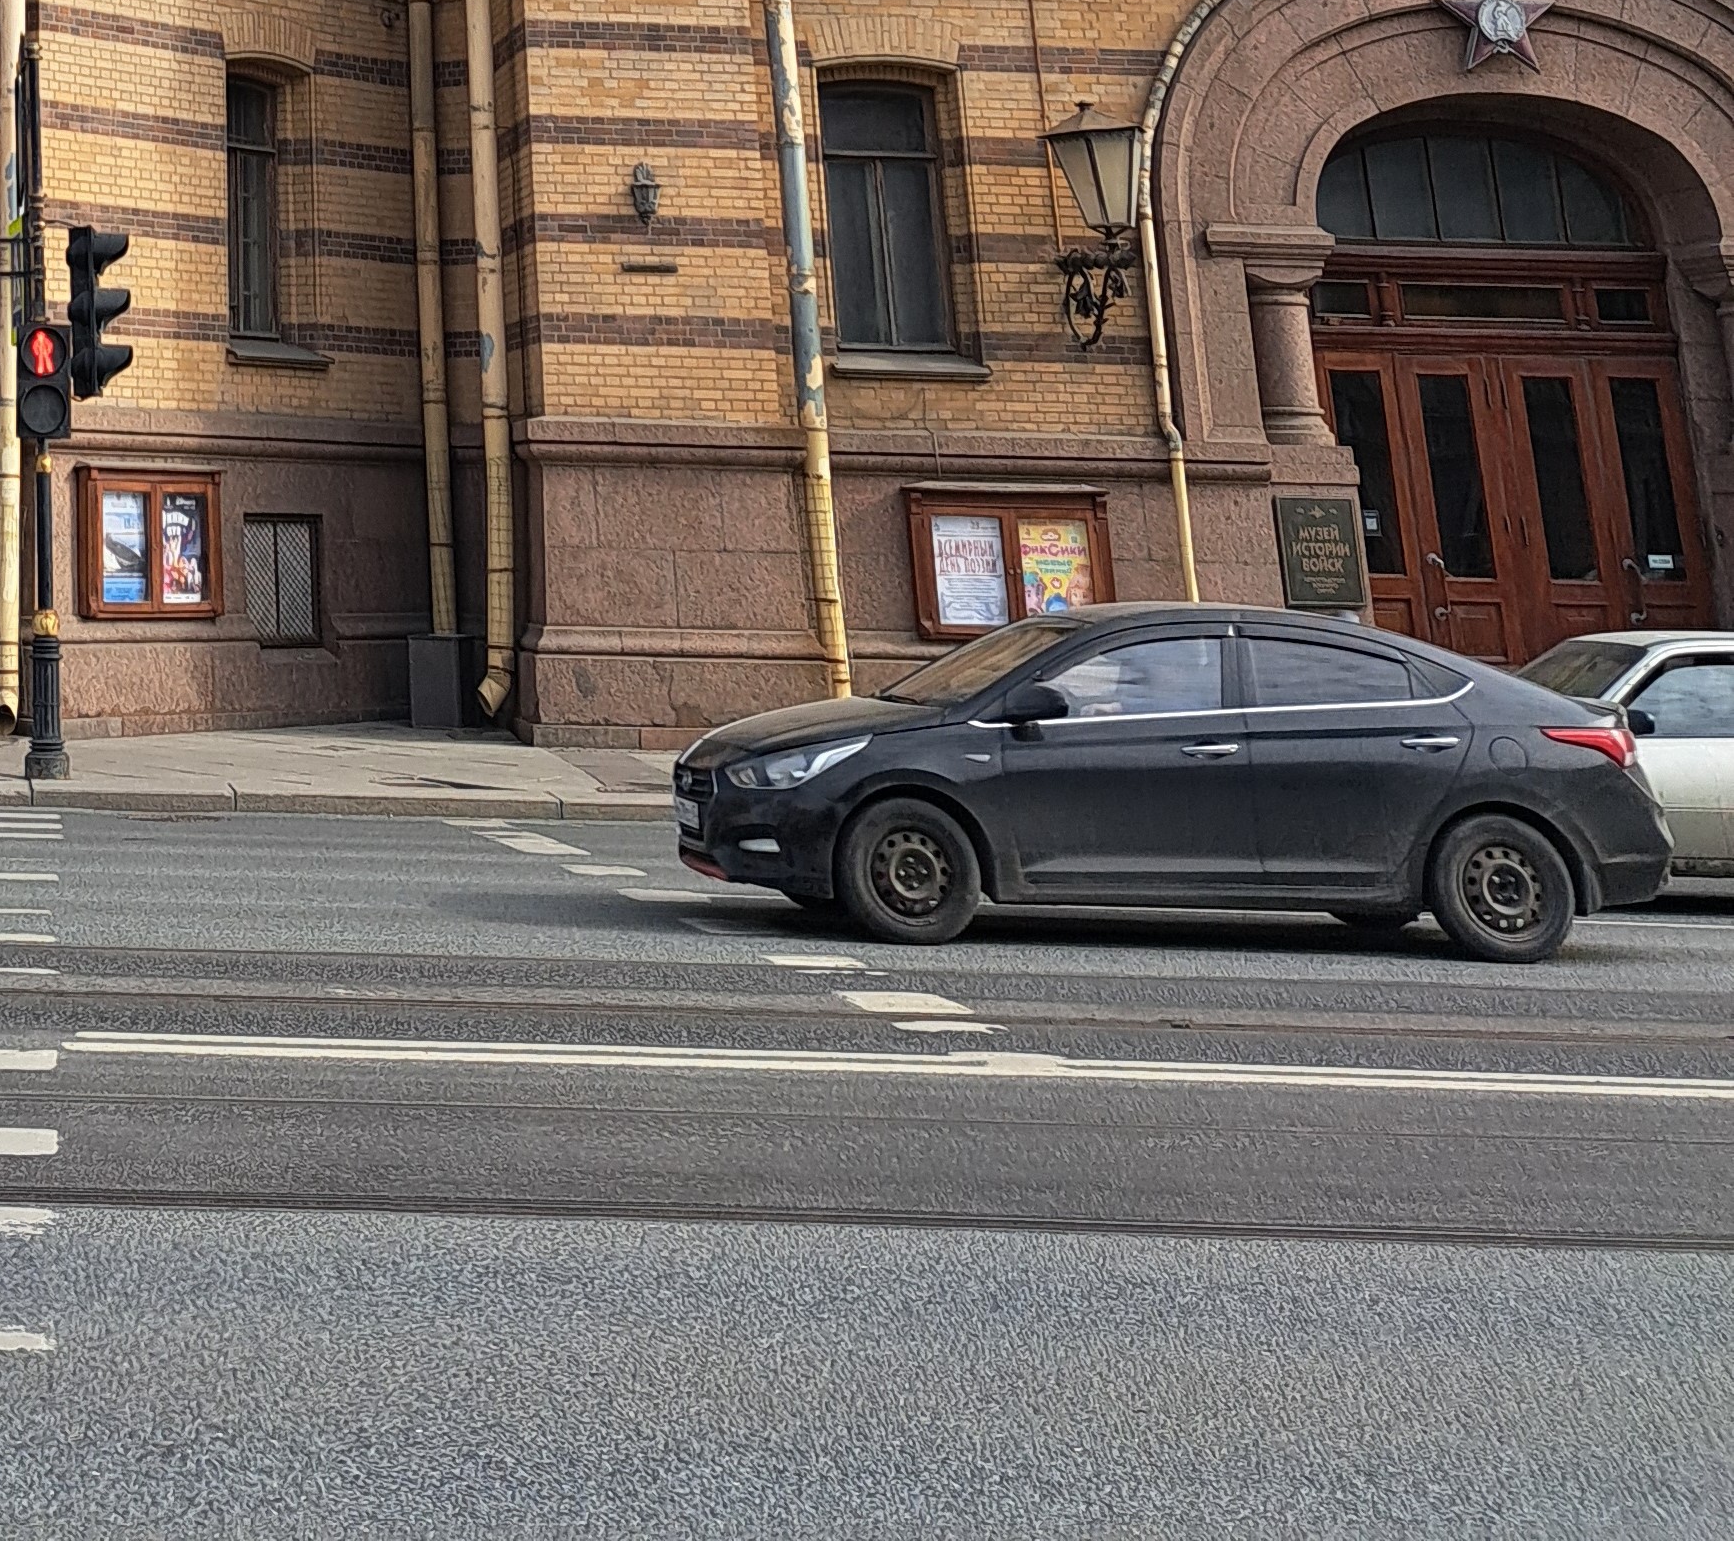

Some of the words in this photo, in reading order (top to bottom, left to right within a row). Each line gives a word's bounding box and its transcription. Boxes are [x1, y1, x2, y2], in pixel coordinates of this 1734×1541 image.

[1298, 524, 1339, 541] МУЗЕЙ
[1292, 541, 1351, 557] ИСТОРИИ
[1302, 556, 1344, 573] ВОЙСК
